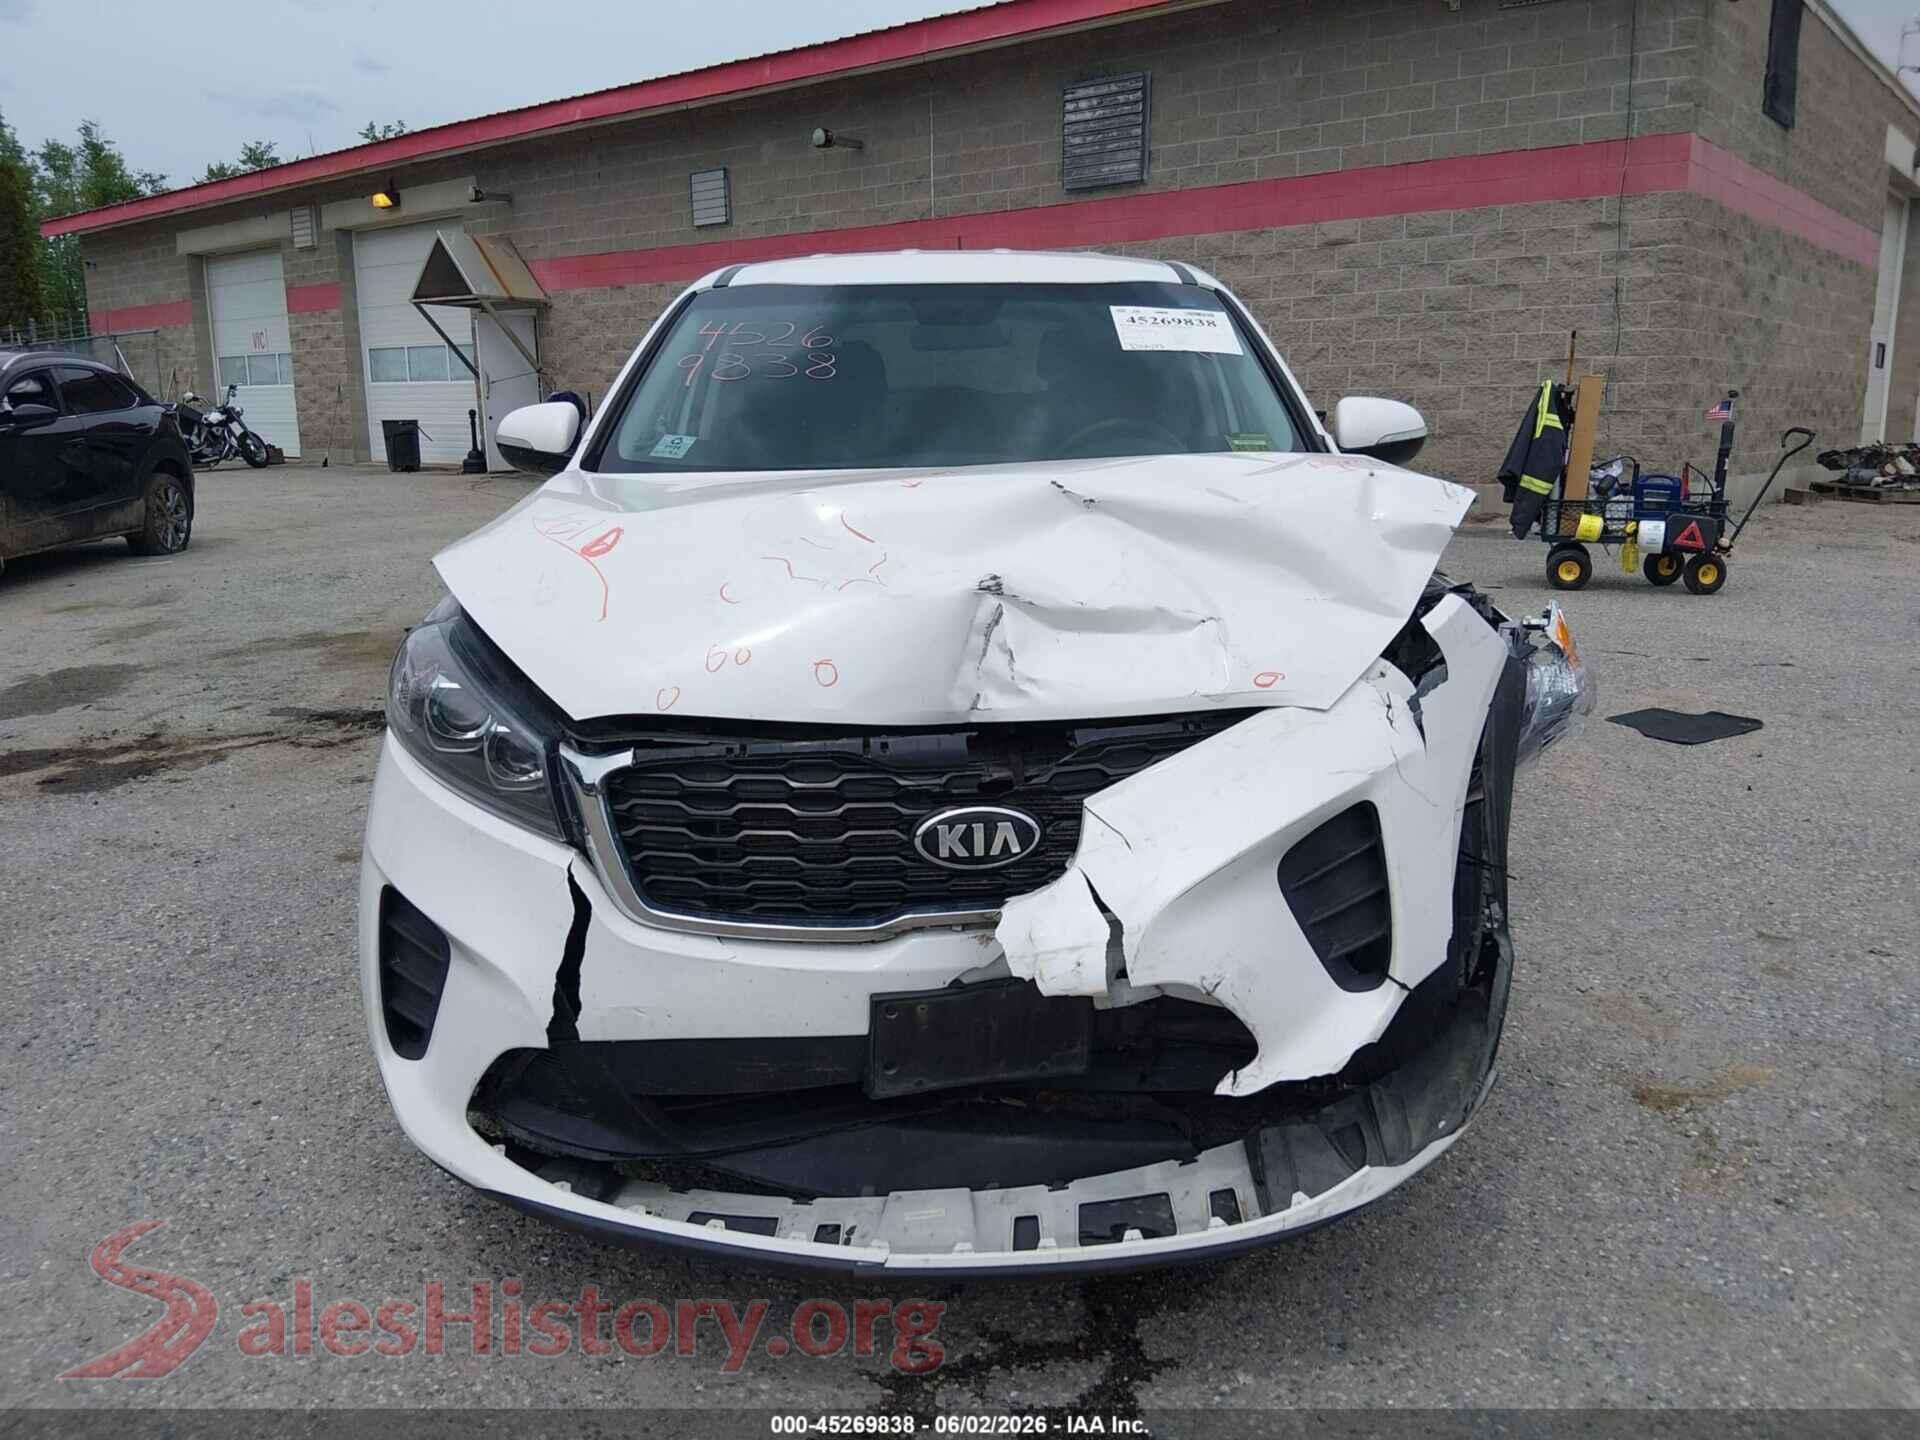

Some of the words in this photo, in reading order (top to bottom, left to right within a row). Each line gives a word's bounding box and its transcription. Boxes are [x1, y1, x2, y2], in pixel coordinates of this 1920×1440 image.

[698, 320, 833, 350] 4526
[1127, 316, 1217, 328] 45269838
[677, 353, 837, 387] 9838
[937, 822, 1021, 858] KIA
